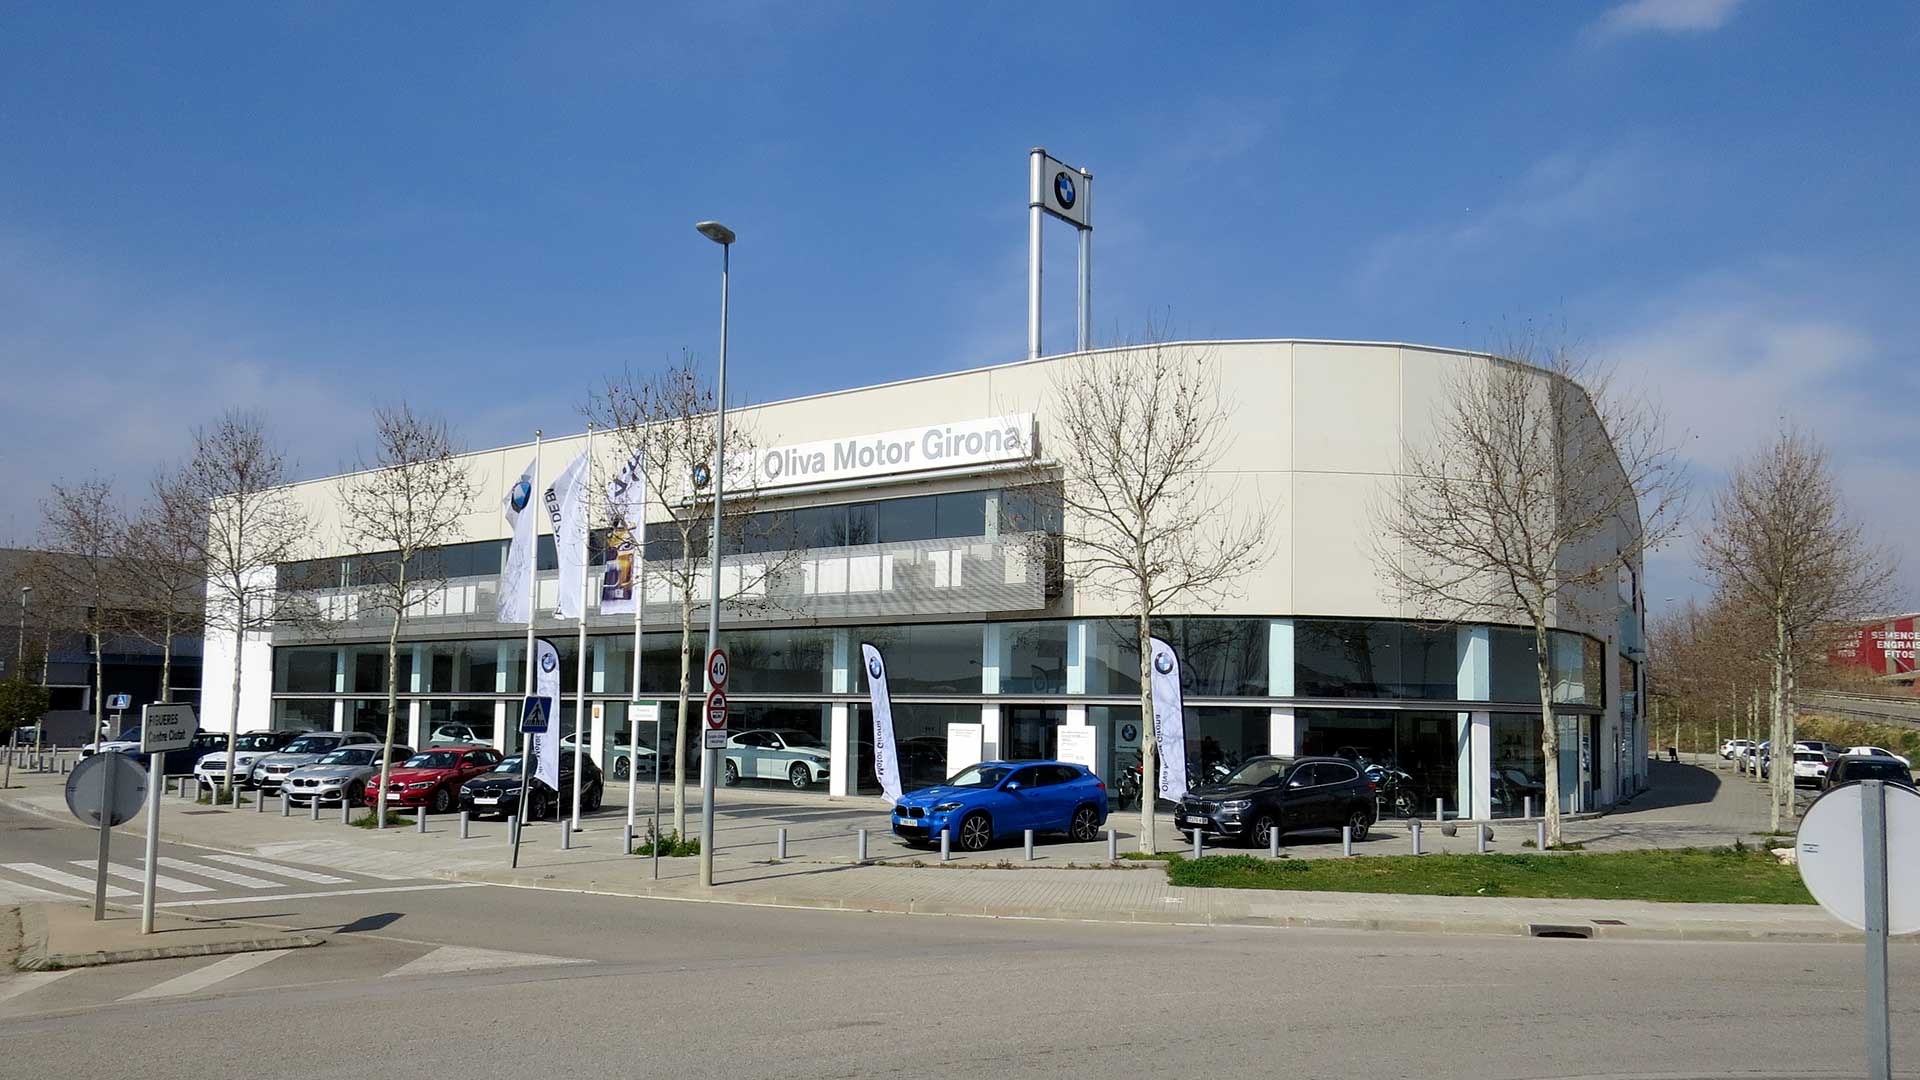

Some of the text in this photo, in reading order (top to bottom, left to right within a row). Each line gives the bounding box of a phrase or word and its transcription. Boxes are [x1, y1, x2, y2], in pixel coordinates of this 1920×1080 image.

[764, 427, 1021, 479] Oliva Motor Girona
[1876, 641, 1920, 649] ENGRAIS
[1884, 650, 1916, 658] FITOS
[712, 662, 725, 676] 40
